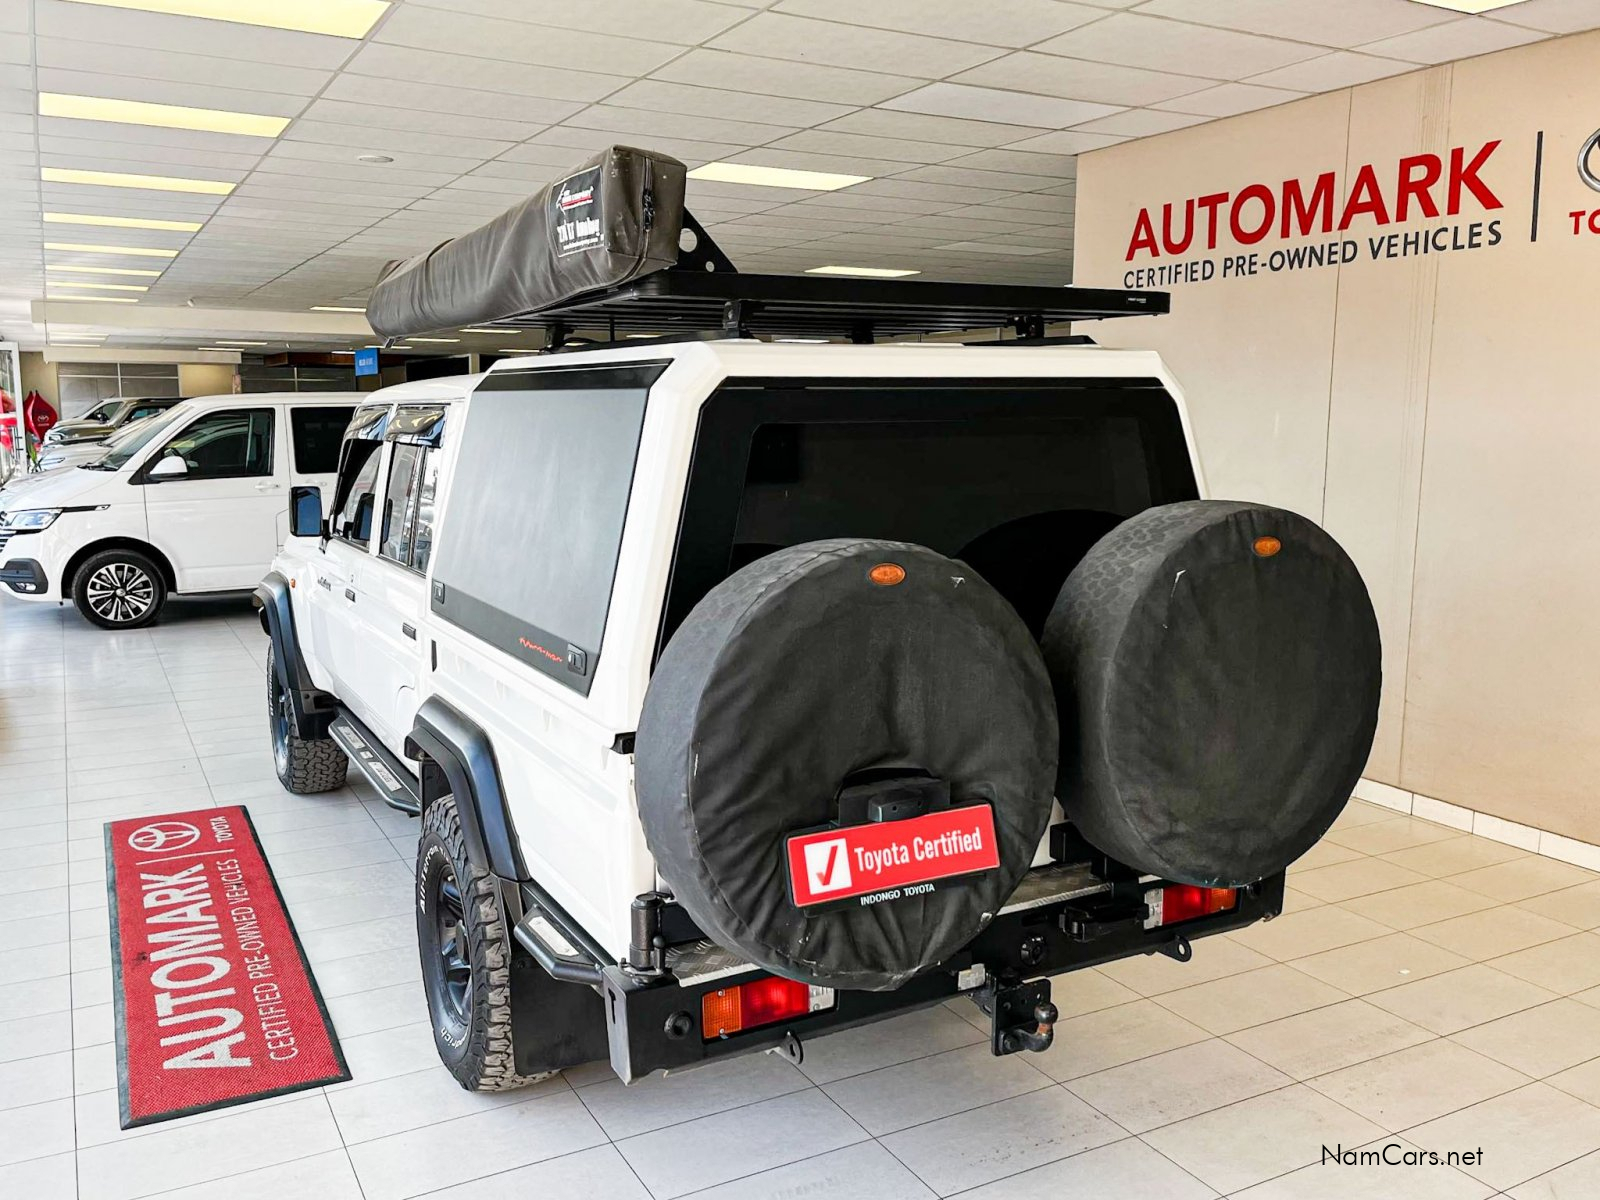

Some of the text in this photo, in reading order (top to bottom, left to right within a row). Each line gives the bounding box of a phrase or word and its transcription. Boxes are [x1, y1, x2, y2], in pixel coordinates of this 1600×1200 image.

[1125, 140, 1504, 261] AUTOMARK
[1124, 220, 1502, 289] CERTIFIED PRE-OWNED VEHICLES
[209, 816, 235, 843] TOYOTA
[853, 826, 983, 875] Toyota Certified
[860, 883, 935, 906] INDONGO TOYOTA
[140, 863, 252, 1070] AUTOMARK
[216, 859, 299, 1061] CERTIFIED PRE-OWNED VEHICLES
